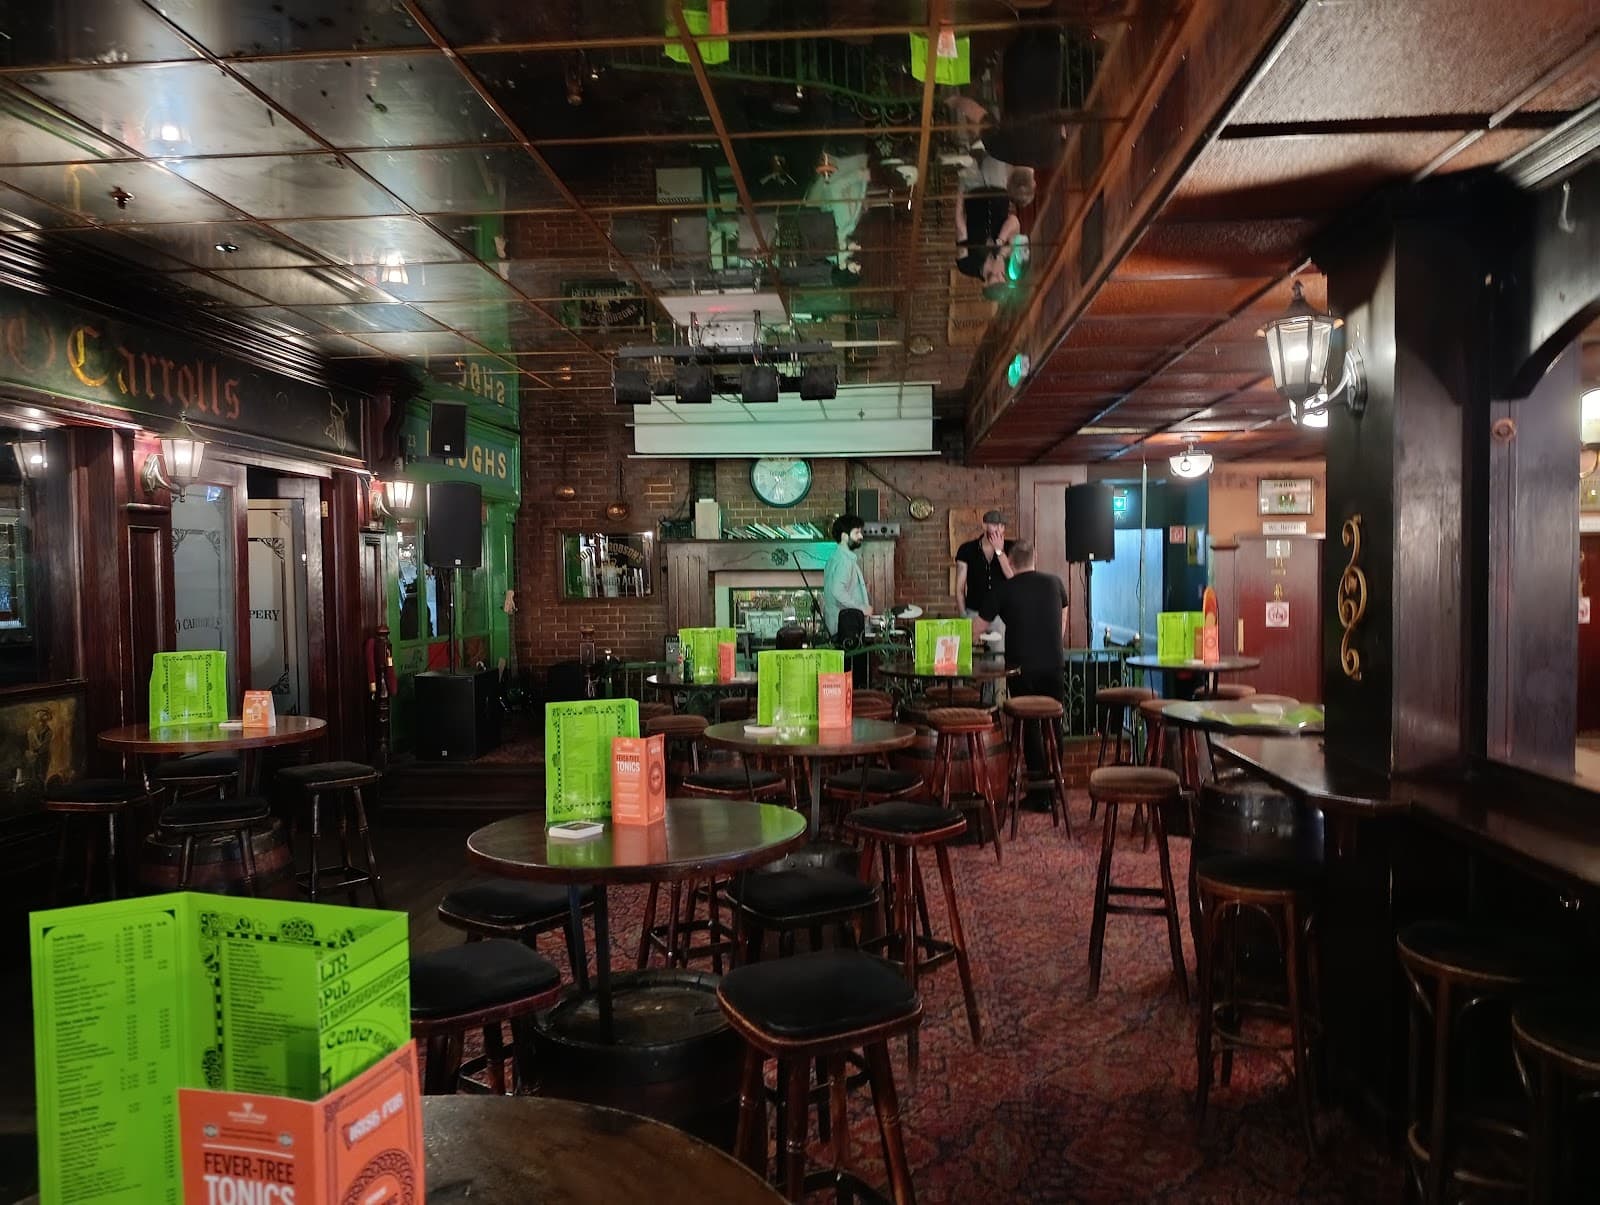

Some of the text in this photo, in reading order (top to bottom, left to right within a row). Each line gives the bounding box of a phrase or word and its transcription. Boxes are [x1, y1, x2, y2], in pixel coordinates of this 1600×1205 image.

[66, 325, 241, 420] Carrolls
[616, 761, 641, 775] TONICS
[203, 1152, 295, 1185] FEVER-TREE
[202, 1175, 295, 1205] TONICS
